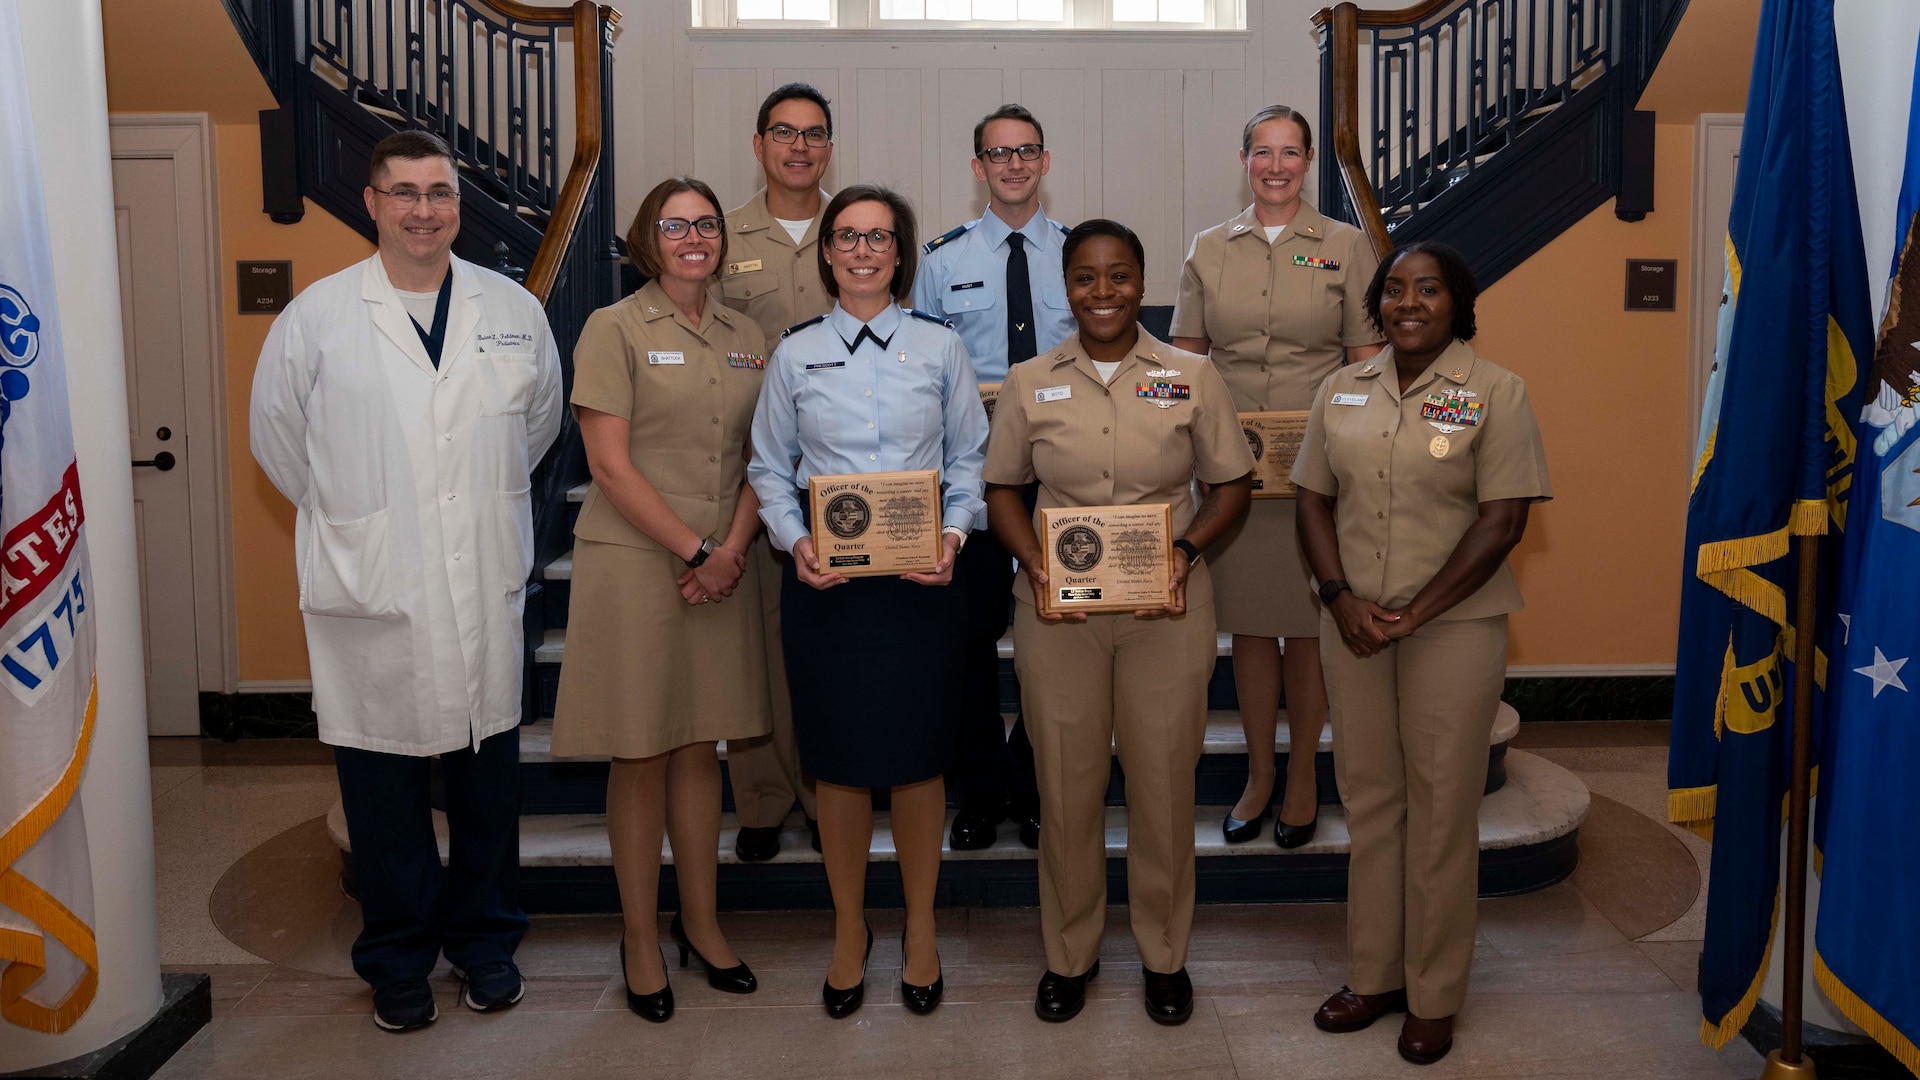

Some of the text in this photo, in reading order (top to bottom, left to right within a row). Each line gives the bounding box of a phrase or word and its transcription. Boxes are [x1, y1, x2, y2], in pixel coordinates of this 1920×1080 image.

[251, 266, 277, 274] Storage
[1640, 264, 1664, 274] Storage
[1254, 422, 1266, 430] the
[820, 484, 848, 498] Officer
[861, 484, 874, 495] the
[1052, 517, 1080, 530] Officer
[1092, 517, 1106, 528] the
[1066, 576, 1096, 585] Quarter
[0, 567, 85, 690] 1775
